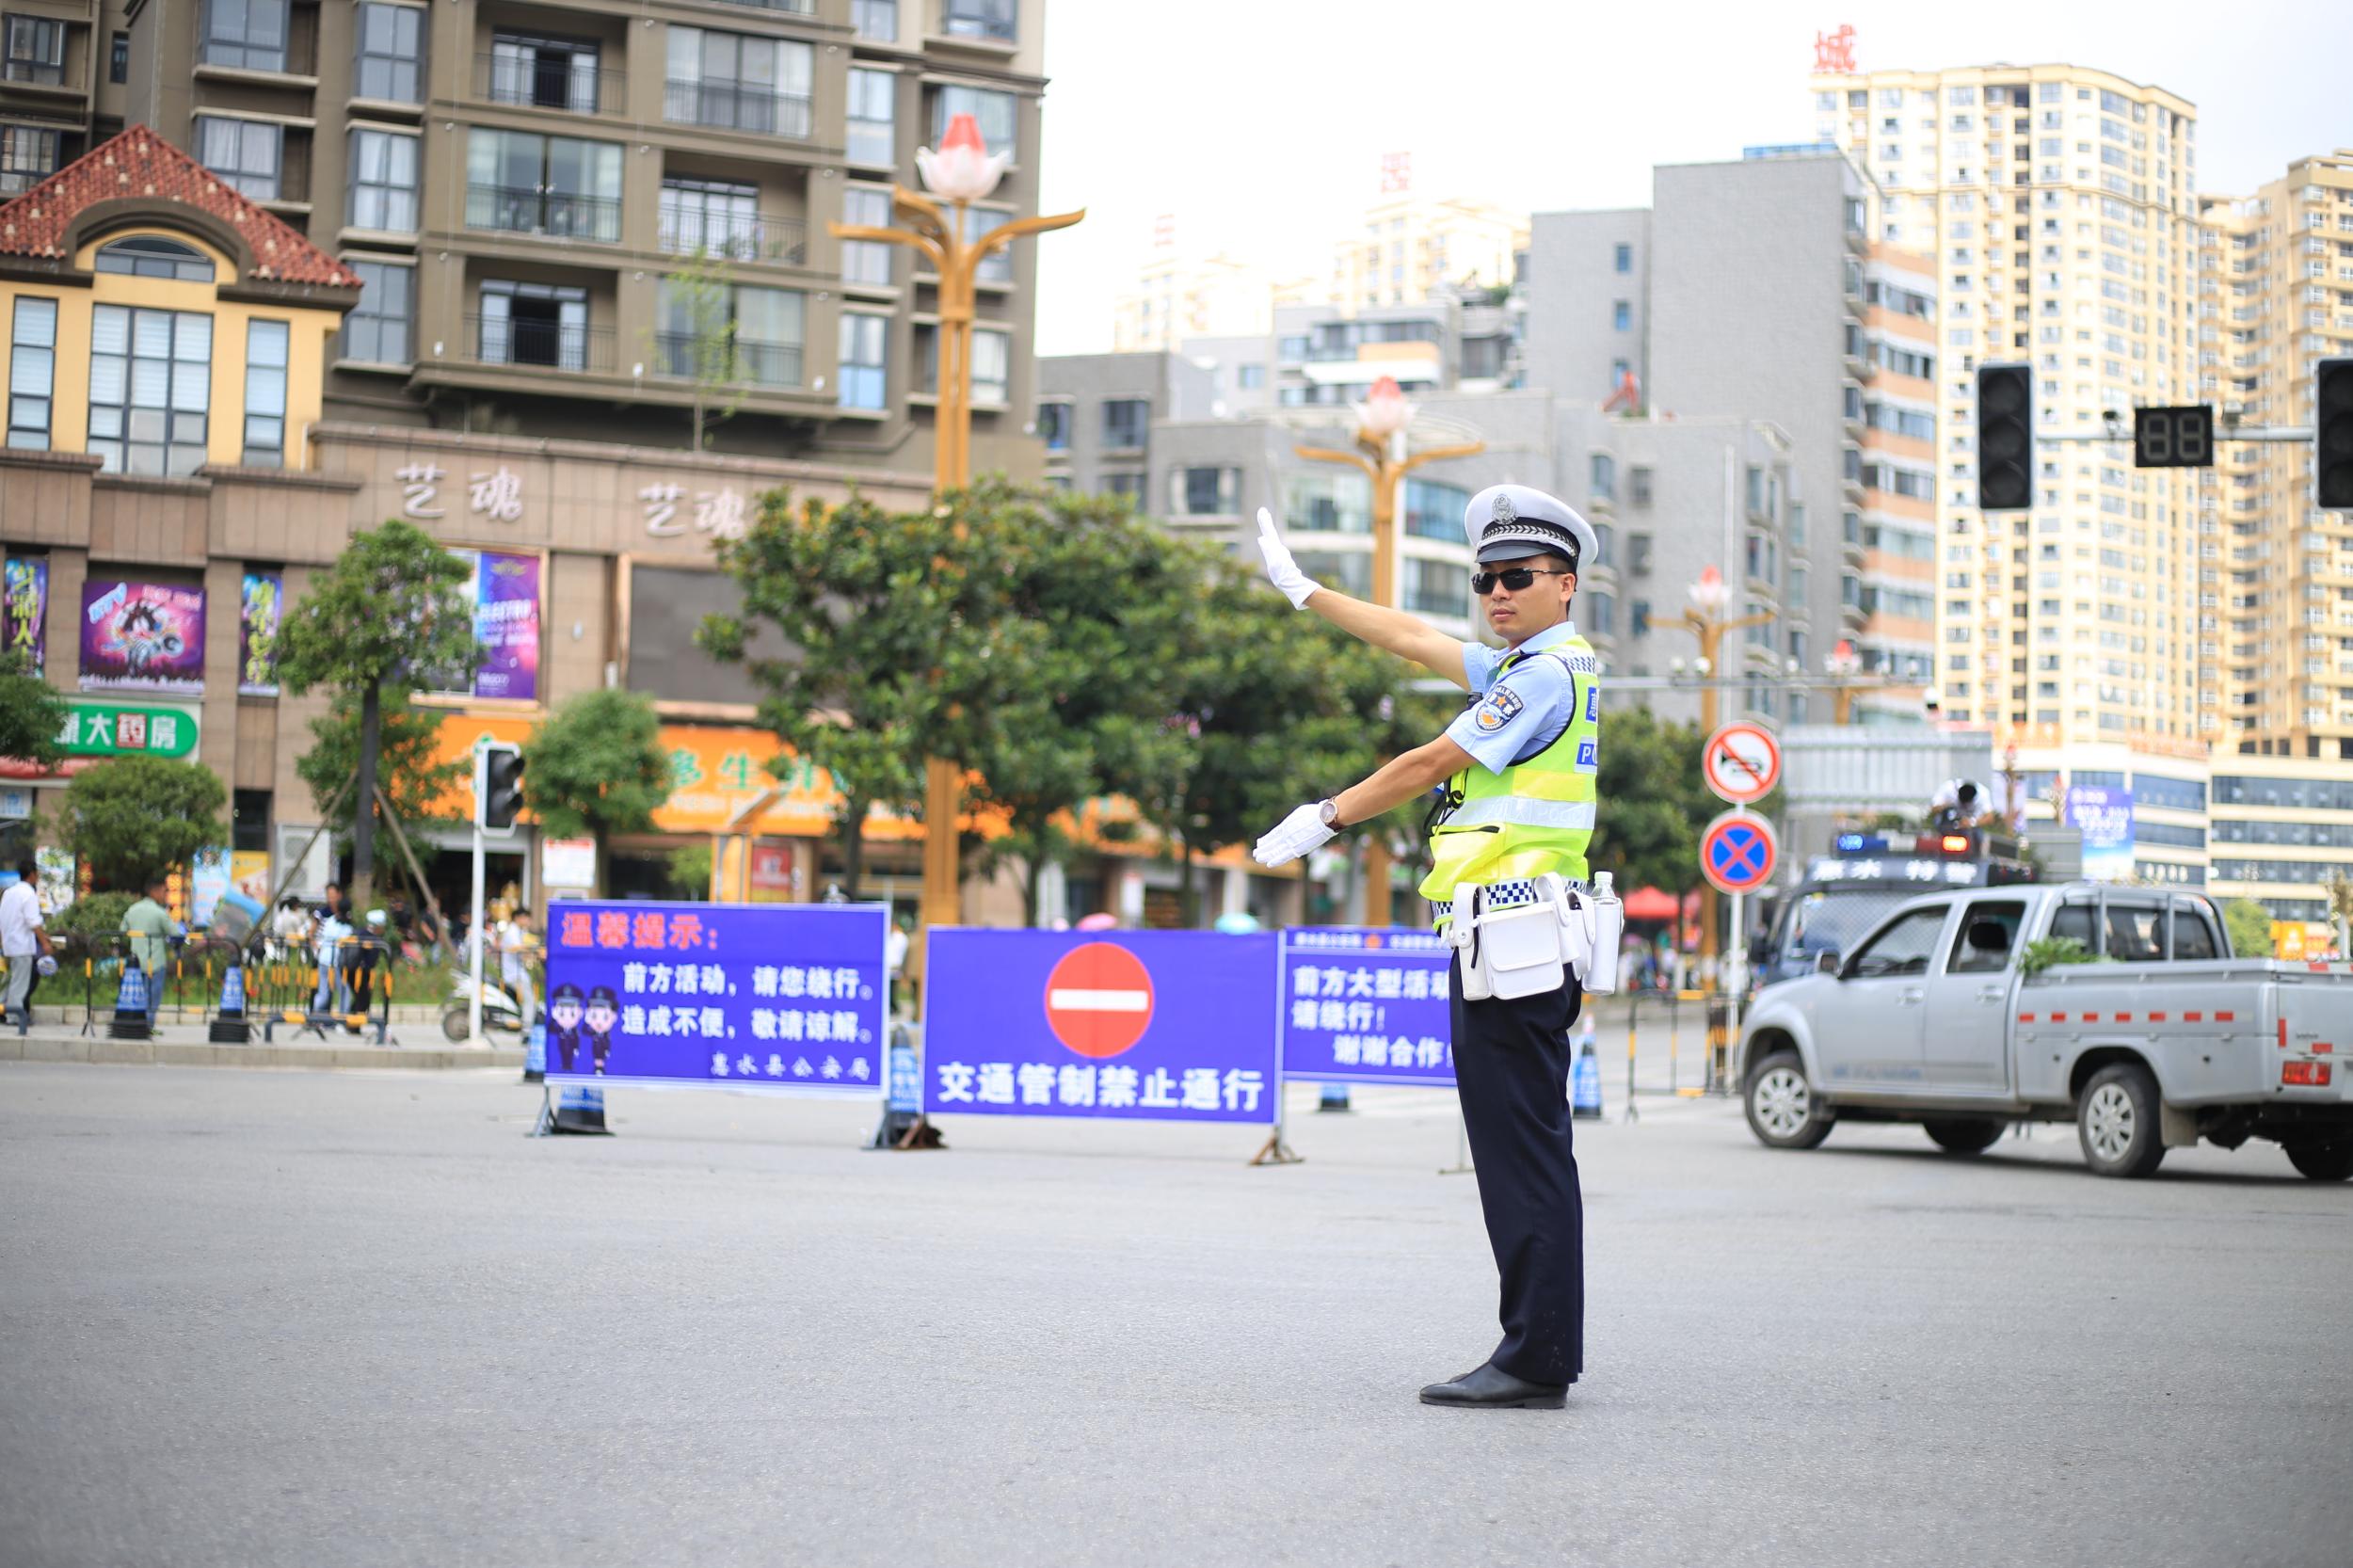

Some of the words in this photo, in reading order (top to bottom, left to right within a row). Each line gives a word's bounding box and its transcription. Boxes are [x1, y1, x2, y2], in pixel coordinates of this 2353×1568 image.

[394, 462, 523, 522] 艺魂
[638, 481, 746, 540] 艺魂
[937, 1062, 1265, 1112] 交通管制禁止通行
